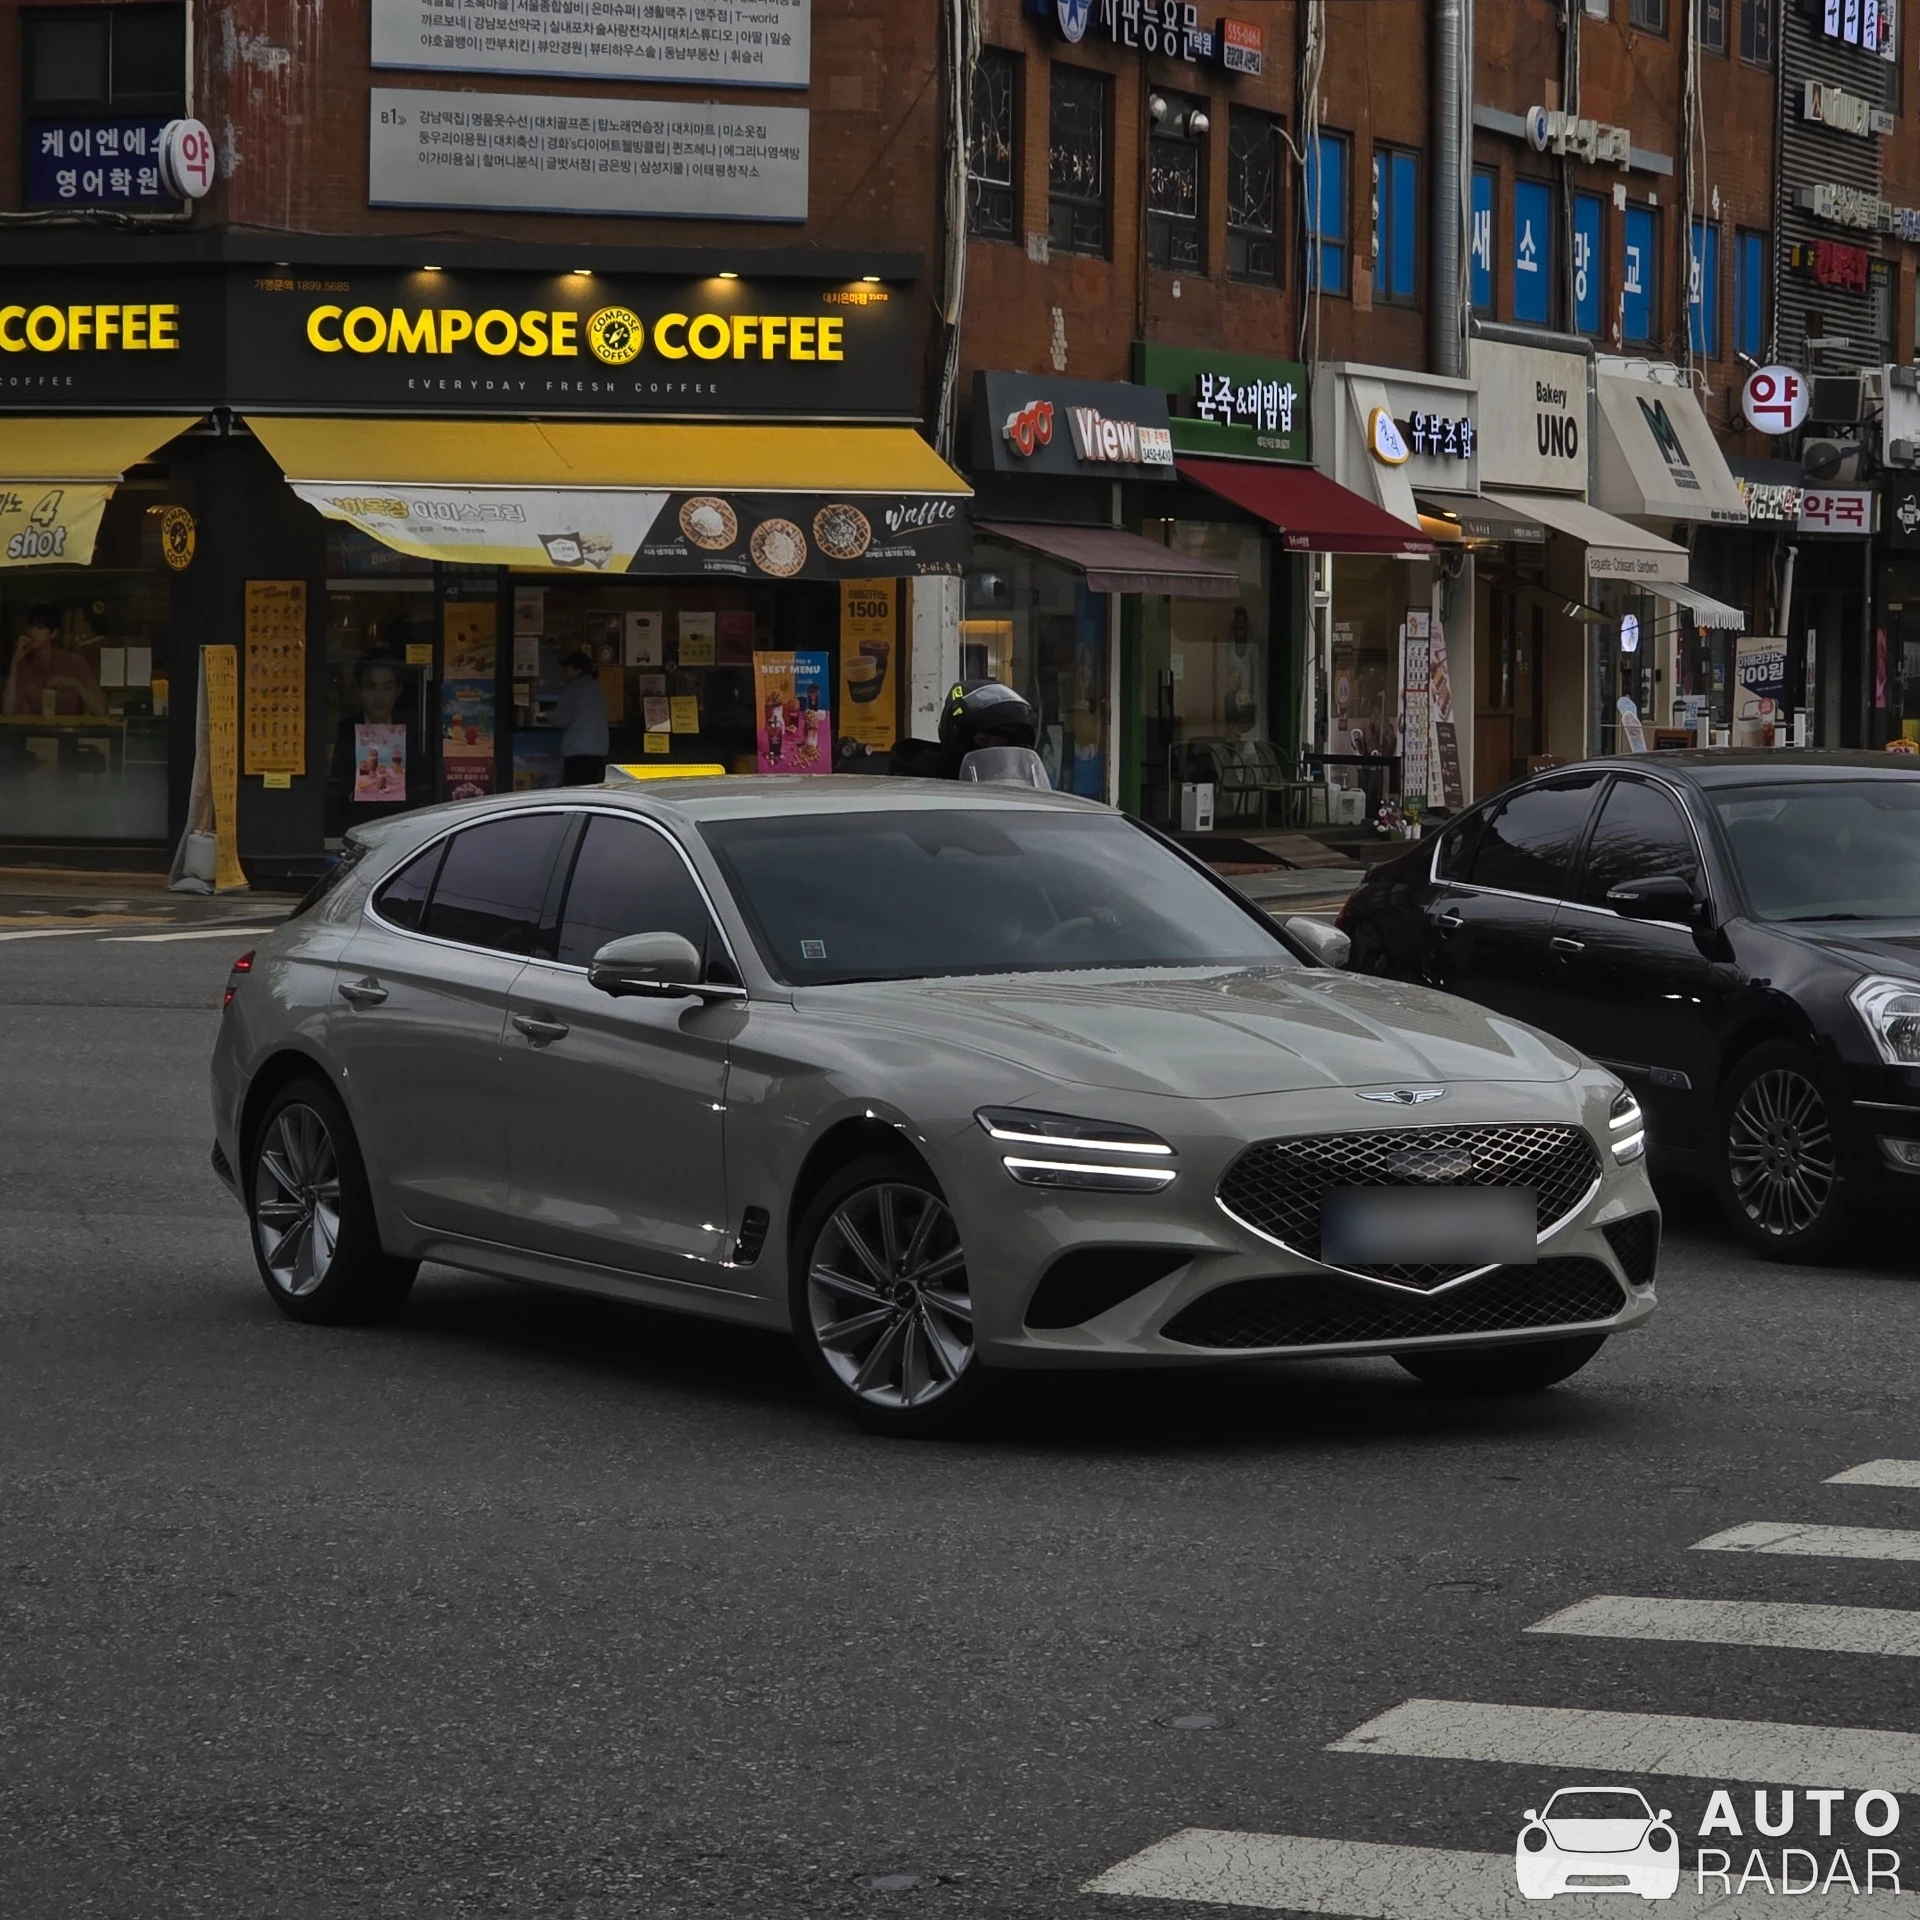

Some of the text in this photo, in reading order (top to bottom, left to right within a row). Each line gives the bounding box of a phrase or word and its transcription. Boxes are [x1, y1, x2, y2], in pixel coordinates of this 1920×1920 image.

[420, 14, 466, 28] 까르보네
[474, 16, 541, 32] 강남보선약국
[735, 11, 779, 24] T-world
[485, 37, 530, 52] 깐부치킨
[538, 40, 582, 54] 뷰안경원
[664, 46, 719, 61] 동남부동산
[419, 111, 464, 125] 강남떡집
[472, 113, 528, 128] 명품옷수선
[535, 115, 591, 131] 대치골프존
[672, 121, 716, 136] 대치마트
[723, 124, 767, 139] 미소옷집
[494, 135, 539, 149] 대치축산
[182, 130, 209, 187] 약
[419, 152, 475, 166] 이가미용실
[483, 153, 539, 169] 할머니분식
[598, 159, 631, 173] 금은방
[56, 168, 158, 198] 영어학원
[254, 279, 350, 292] 가맹문의 1899.5685
[0, 304, 179, 352] COFFEE
[306, 304, 844, 361] COMPOSE COFFEE
[593, 310, 640, 333] COMPOSE
[597, 344, 636, 361] COFFEE
[409, 378, 718, 394] EVERYDAY FRESH COFFEE
[1536, 380, 1567, 410] Bakery
[1197, 373, 1298, 432] 본죽&비빔밥
[1750, 374, 1798, 428] 약
[1075, 407, 1137, 462] View
[1412, 412, 1474, 459] 유부초밥
[1536, 413, 1579, 460] UNO
[31, 490, 64, 527] 4
[163, 508, 194, 535] COMPOSE
[1804, 495, 1864, 527] 약국
[7, 526, 67, 560] shot
[166, 547, 192, 566] COFFEE
[848, 601, 888, 618] 1500
[761, 665, 820, 674] BEST MENU
[1737, 651, 1784, 669] 아메리카노
